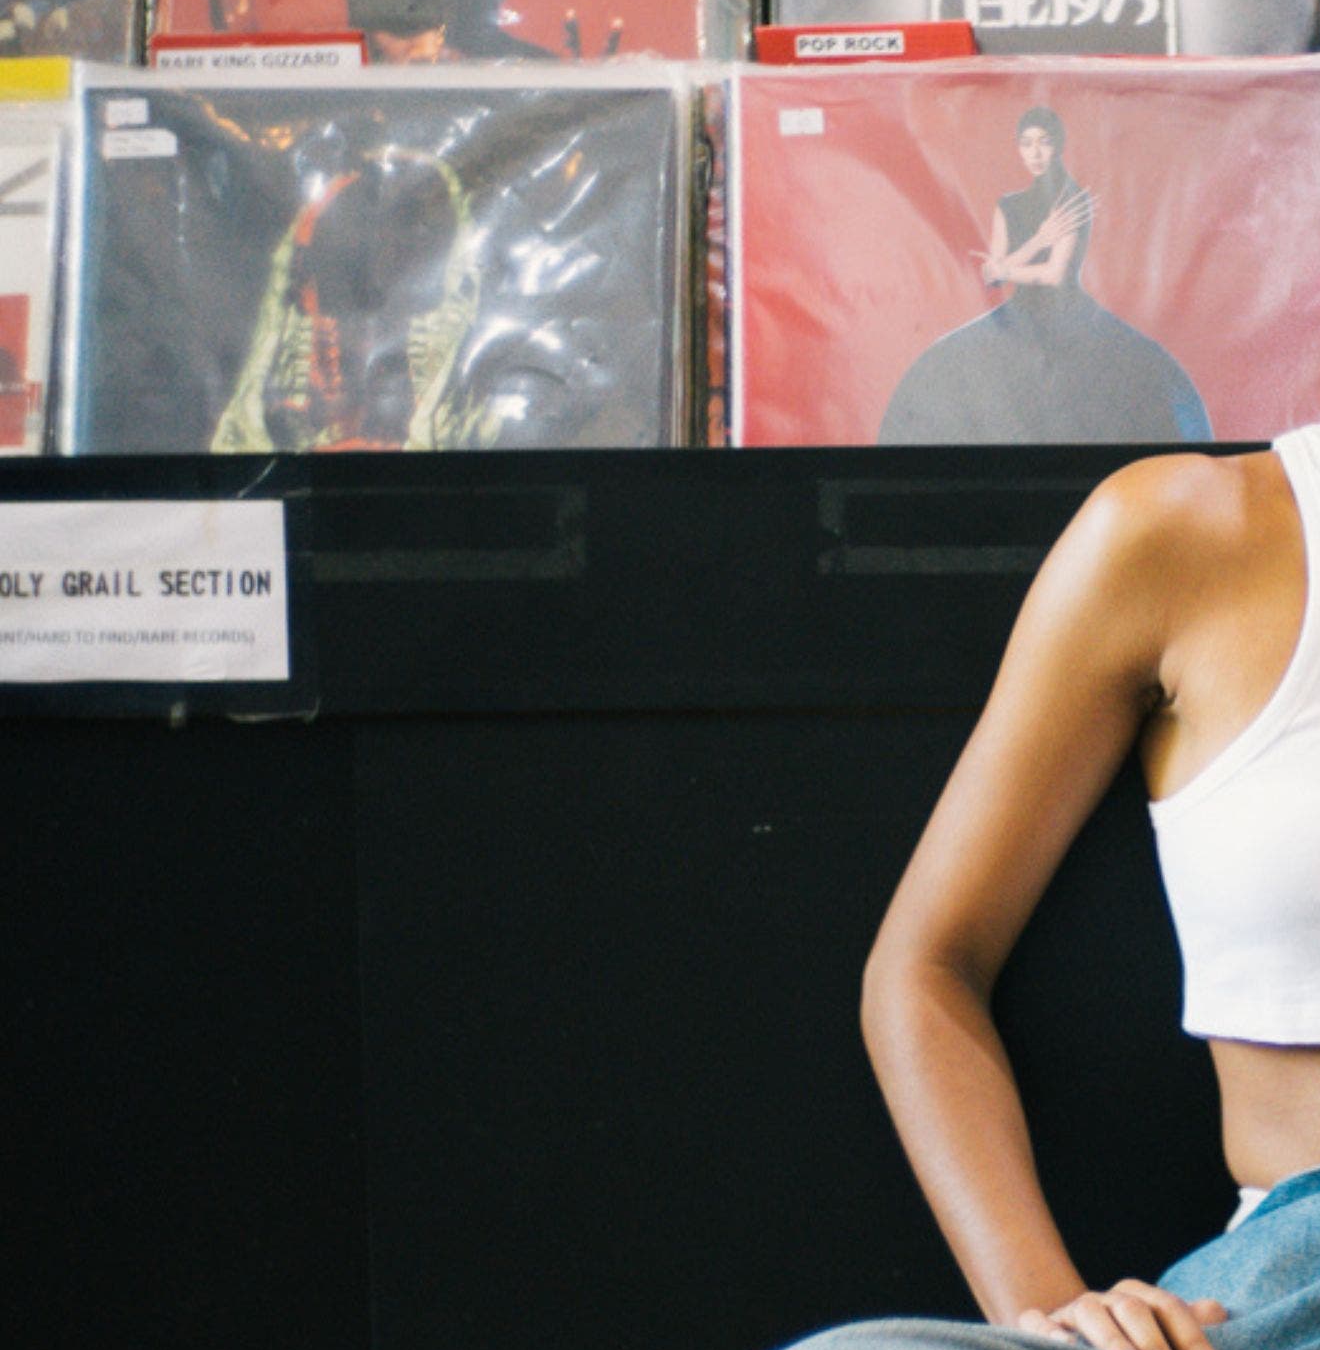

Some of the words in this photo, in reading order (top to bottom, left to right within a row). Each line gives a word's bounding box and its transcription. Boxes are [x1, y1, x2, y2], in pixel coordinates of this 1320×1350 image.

[797, 36, 838, 53] POP
[844, 34, 902, 52] ROCK
[62, 569, 142, 598] GRAIL
[158, 569, 273, 597] SECTION
[75, 630, 96, 645] TO
